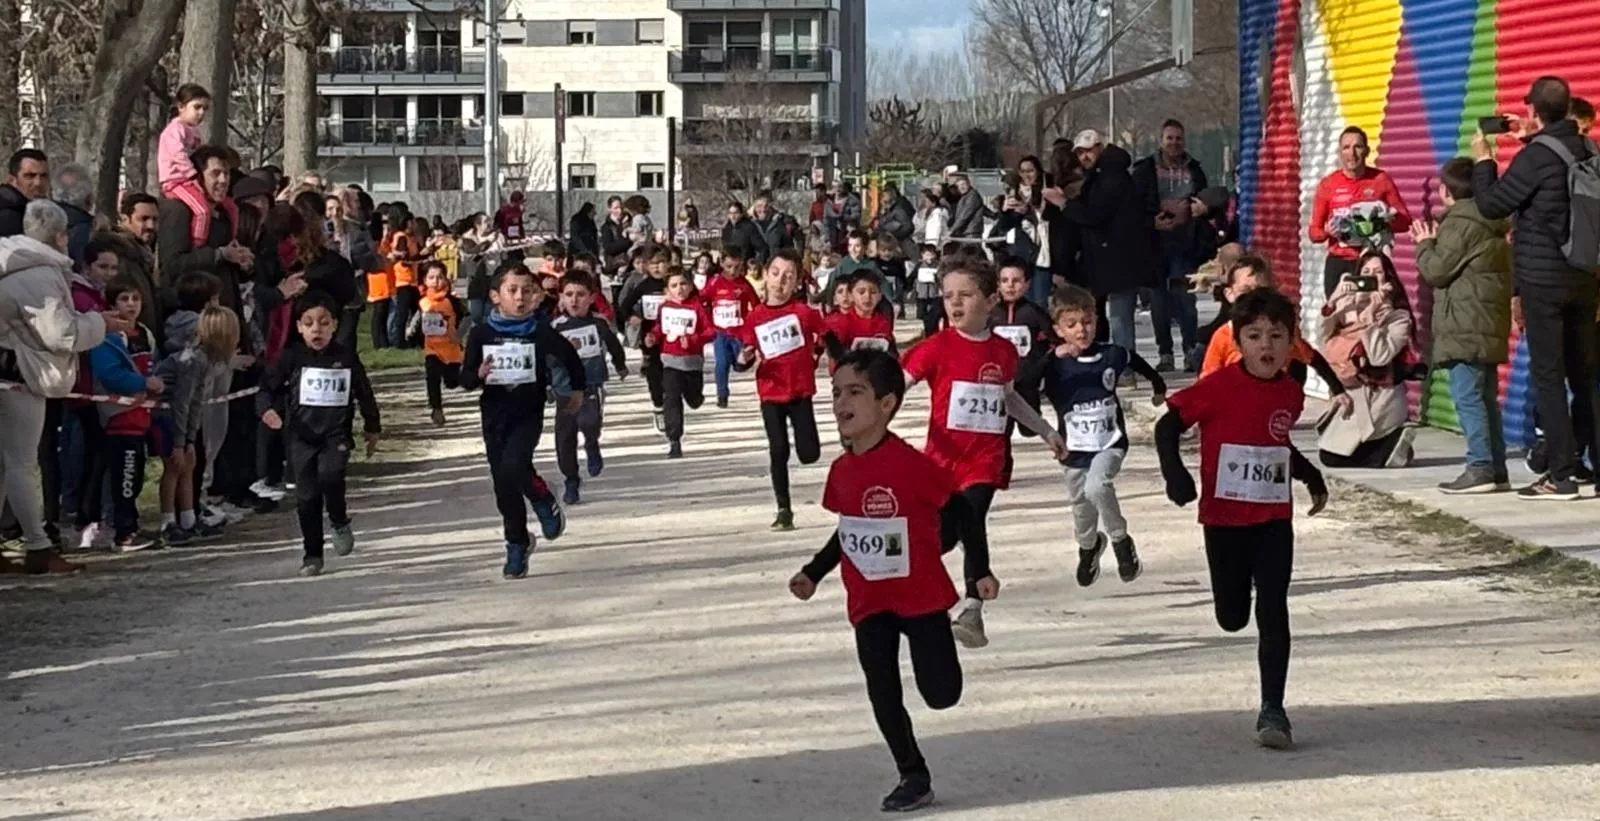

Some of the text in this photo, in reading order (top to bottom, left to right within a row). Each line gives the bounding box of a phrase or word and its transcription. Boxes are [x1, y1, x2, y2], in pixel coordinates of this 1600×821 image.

[497, 355, 522, 369] 226
[314, 378, 337, 391] 371
[968, 397, 998, 414] 234
[1081, 419, 1107, 434] 373
[1241, 462, 1274, 482] 186
[848, 532, 884, 554] 369
